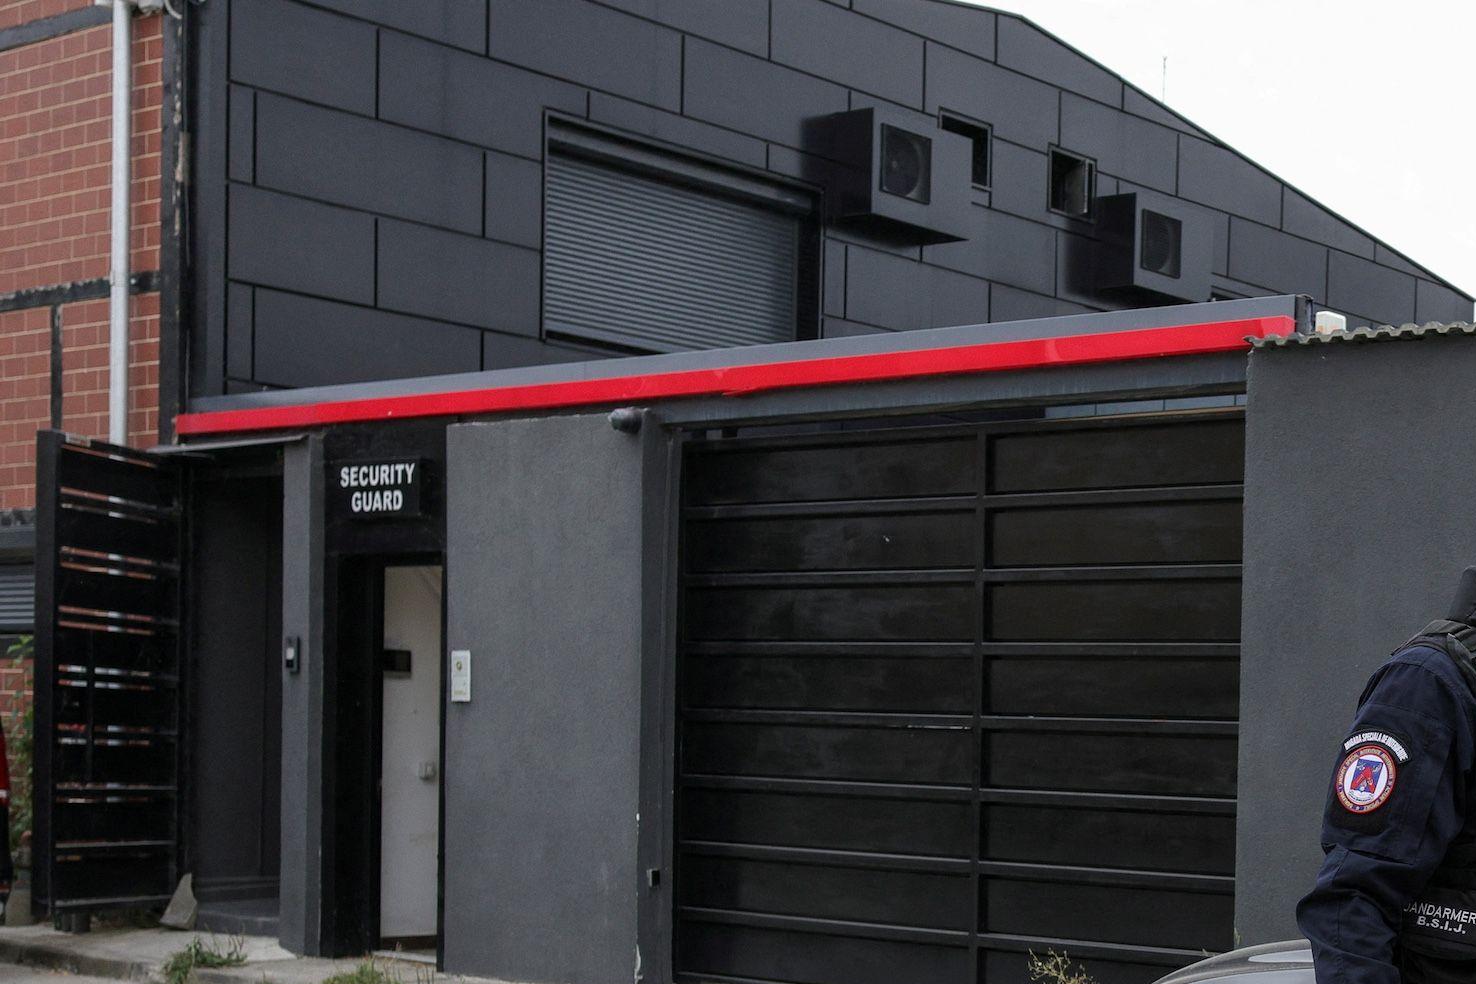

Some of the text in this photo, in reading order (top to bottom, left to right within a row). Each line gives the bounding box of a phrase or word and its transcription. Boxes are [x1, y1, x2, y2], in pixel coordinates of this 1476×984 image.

[339, 462, 416, 488] SECURITY
[351, 489, 403, 512] GUARD
[1416, 915, 1466, 935] B.S.I.J.
